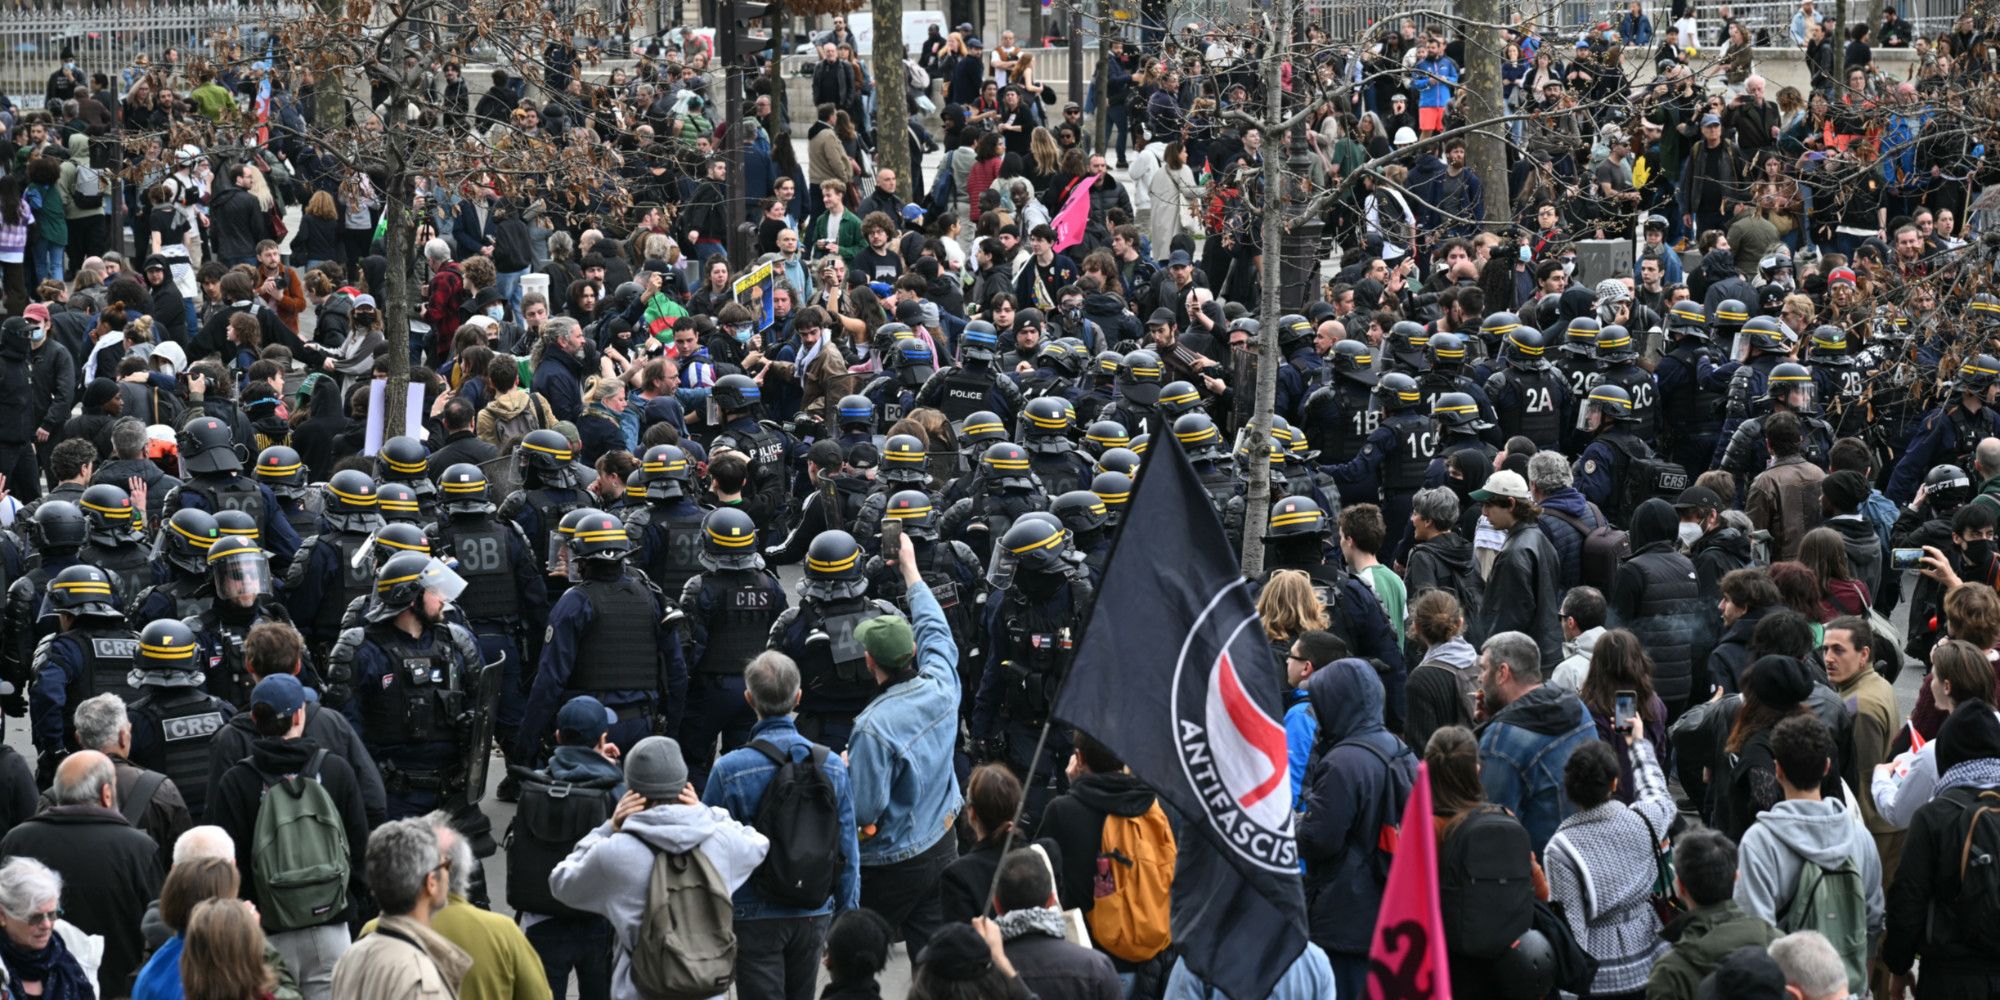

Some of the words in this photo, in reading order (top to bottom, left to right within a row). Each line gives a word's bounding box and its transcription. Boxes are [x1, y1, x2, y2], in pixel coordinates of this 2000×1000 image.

[949, 389, 983, 401] POLICE
[1841, 371, 1863, 396] 2B
[1526, 388, 1554, 413] 2A
[1632, 383, 1652, 410] 2C
[1352, 411, 1380, 436] 1B
[1407, 432, 1436, 458] 1C
[1663, 475, 1684, 488] CRS
[463, 537, 500, 571] 3B
[736, 591, 769, 607] CRS
[100, 640, 137, 655] CRS
[170, 716, 219, 738] CRS
